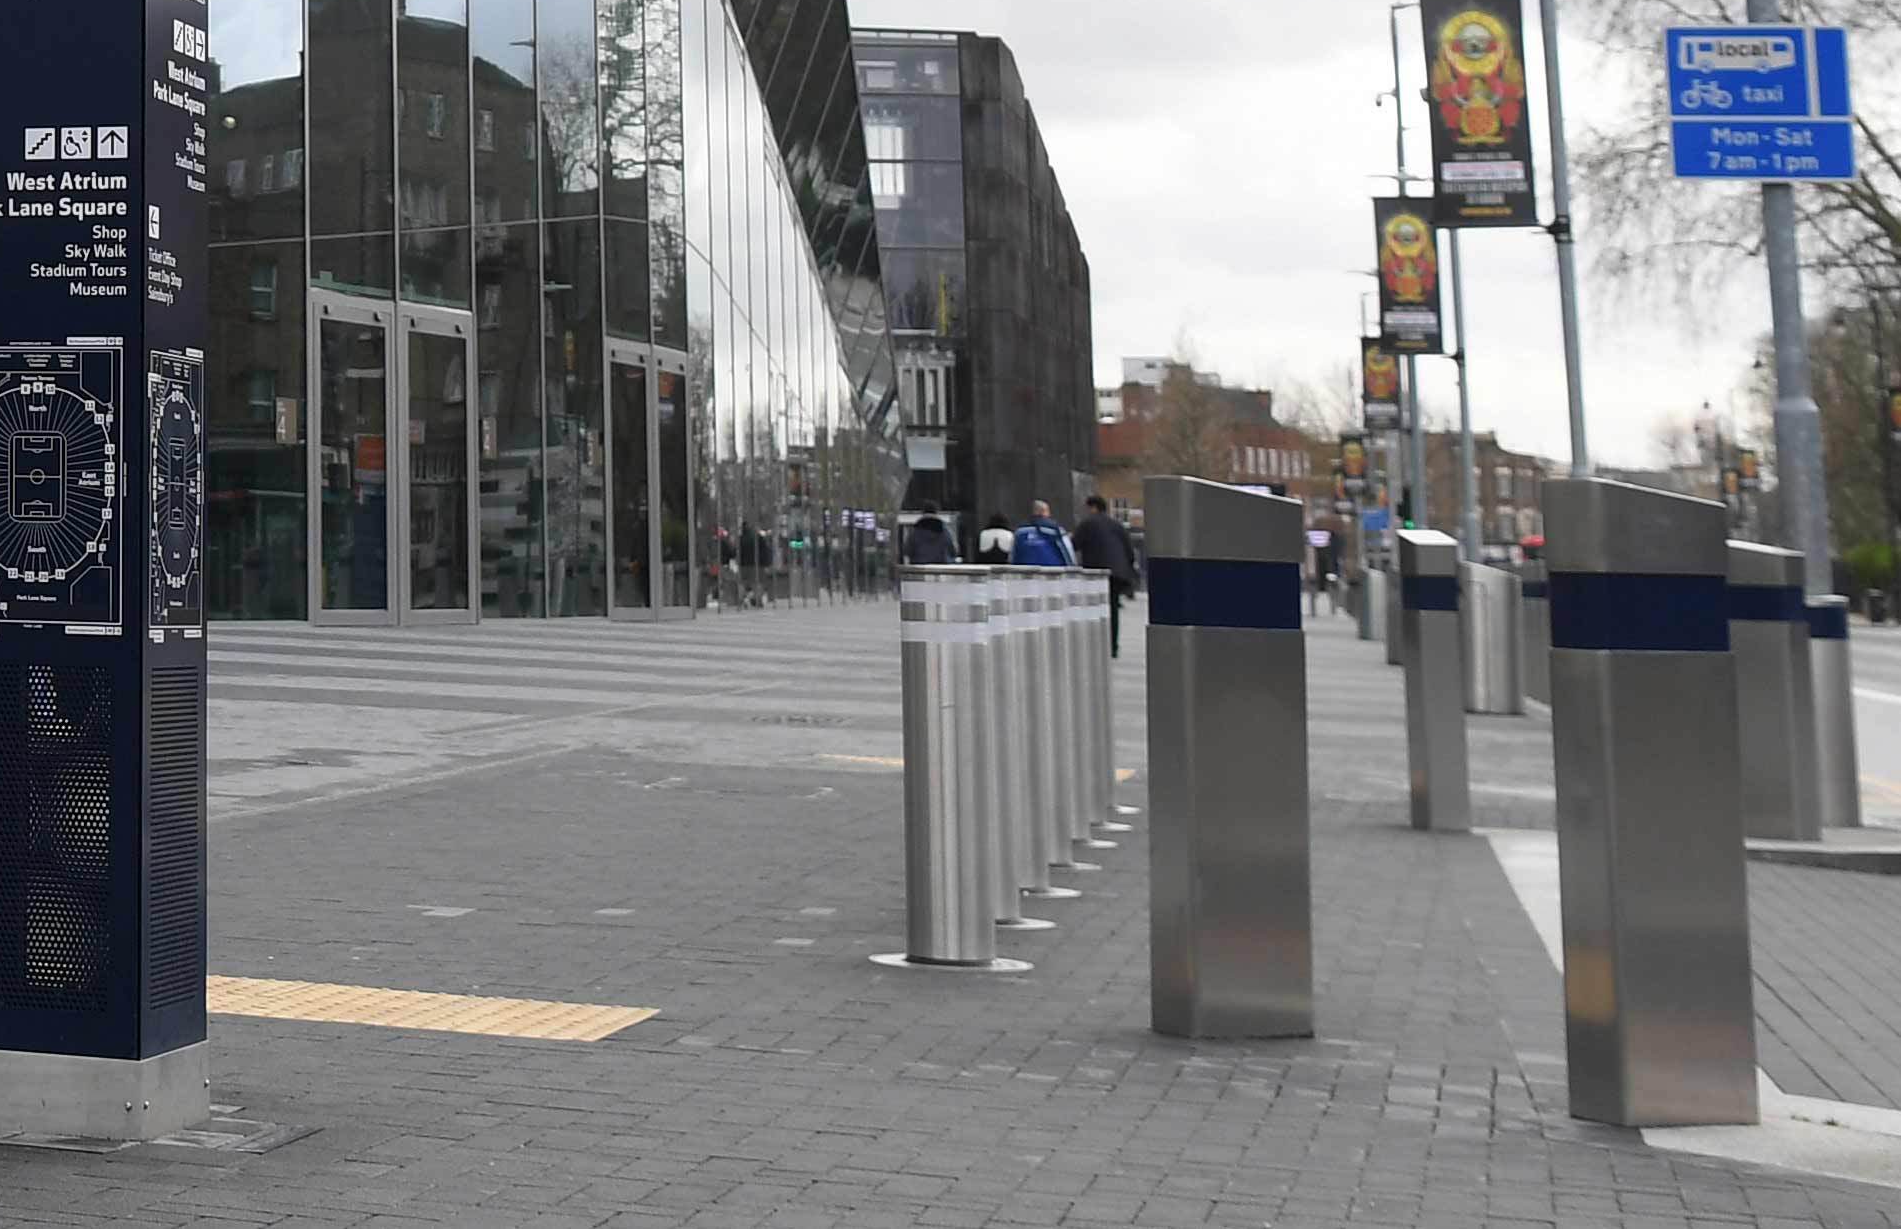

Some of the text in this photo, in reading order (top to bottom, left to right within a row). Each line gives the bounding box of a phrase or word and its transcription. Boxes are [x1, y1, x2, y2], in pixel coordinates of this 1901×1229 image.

[1715, 41, 1769, 58] local
[167, 59, 206, 92] West Atrium
[153, 78, 206, 117] Park Lane Square
[1742, 84, 1784, 103] taxi
[1710, 127, 1760, 147] Mon
[1774, 127, 1814, 147] Sat
[6, 171, 127, 191] West Atrium
[8, 198, 54, 217] Lane
[58, 197, 127, 221] Square
[92, 225, 127, 243] Shop
[65, 243, 127, 261] Sky Walk
[30, 262, 127, 277] Stadium Tours
[69, 282, 127, 296] Museum
